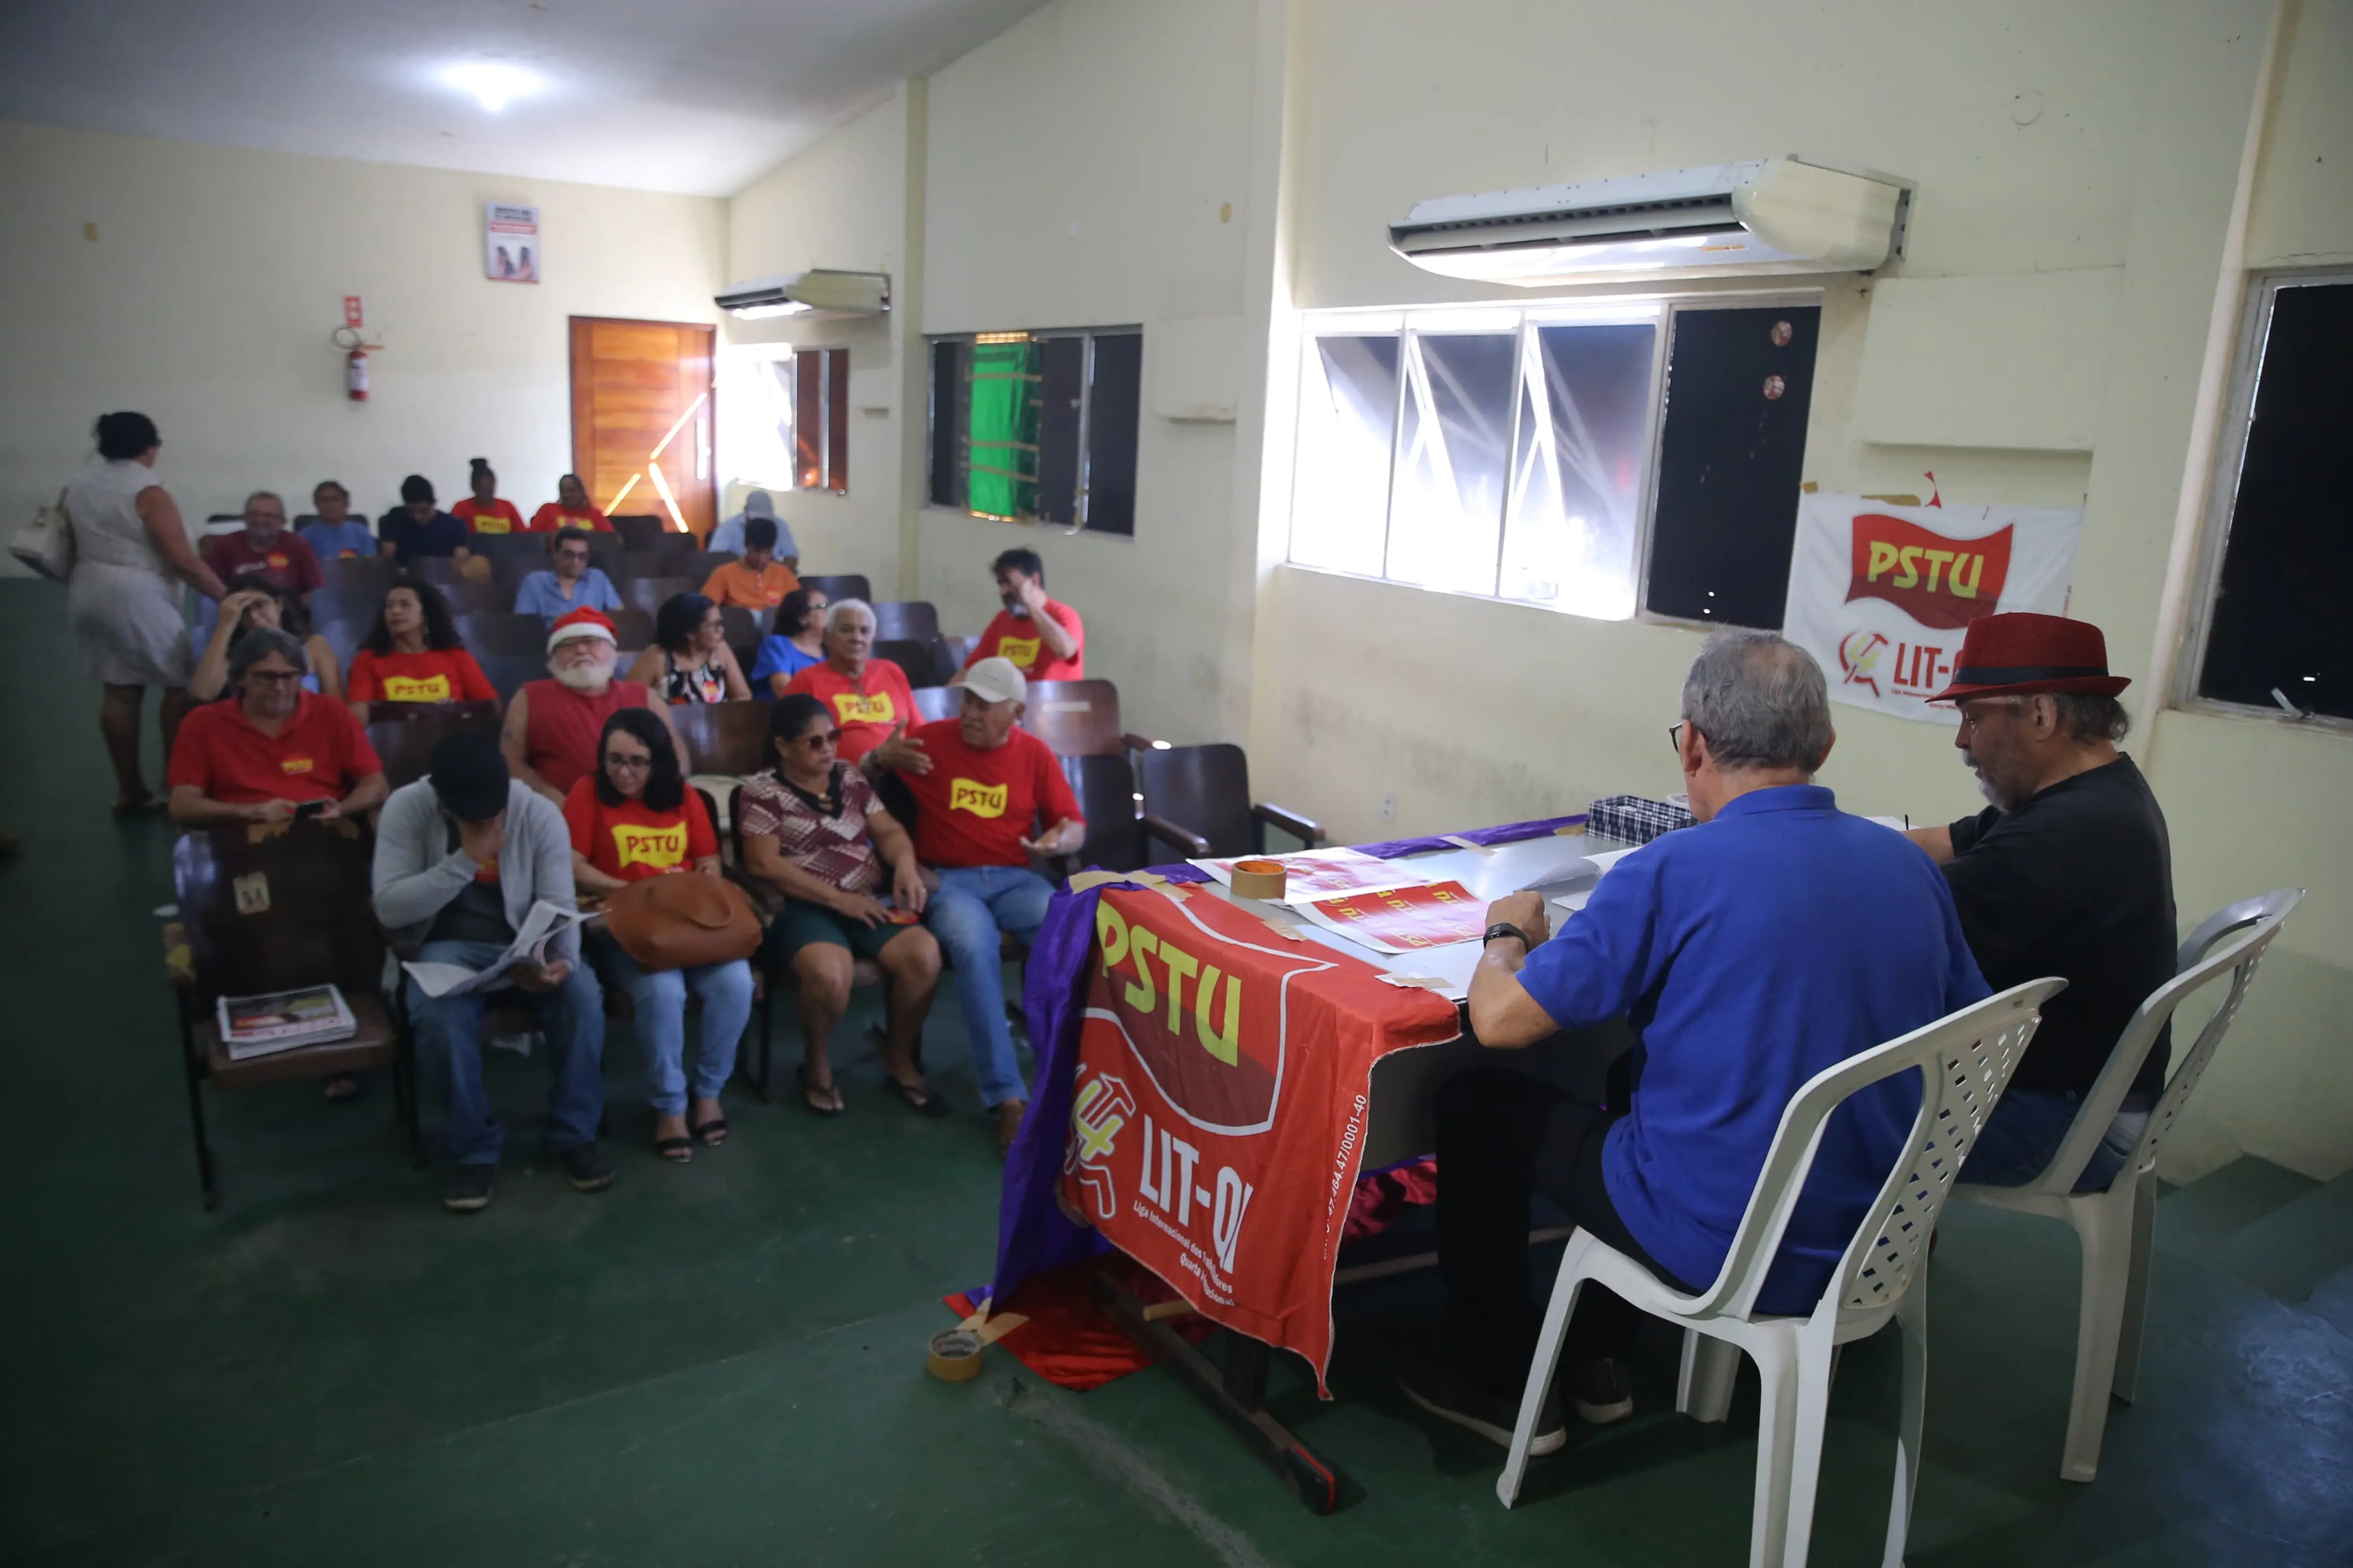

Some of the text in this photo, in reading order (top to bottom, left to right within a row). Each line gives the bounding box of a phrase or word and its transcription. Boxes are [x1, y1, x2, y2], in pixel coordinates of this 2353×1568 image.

[1868, 541, 1984, 598] PSTU
[395, 684, 440, 695] PSTU
[957, 788, 1002, 809] PSTU
[626, 836, 678, 853] PSTU
[1096, 898, 1242, 1068] PSTU
[1134, 1200, 1149, 1218] Liga
[1149, 1209, 1190, 1249] Internacional
[1190, 1243, 1203, 1259] dos
[1180, 1252, 1201, 1277] Quarta
